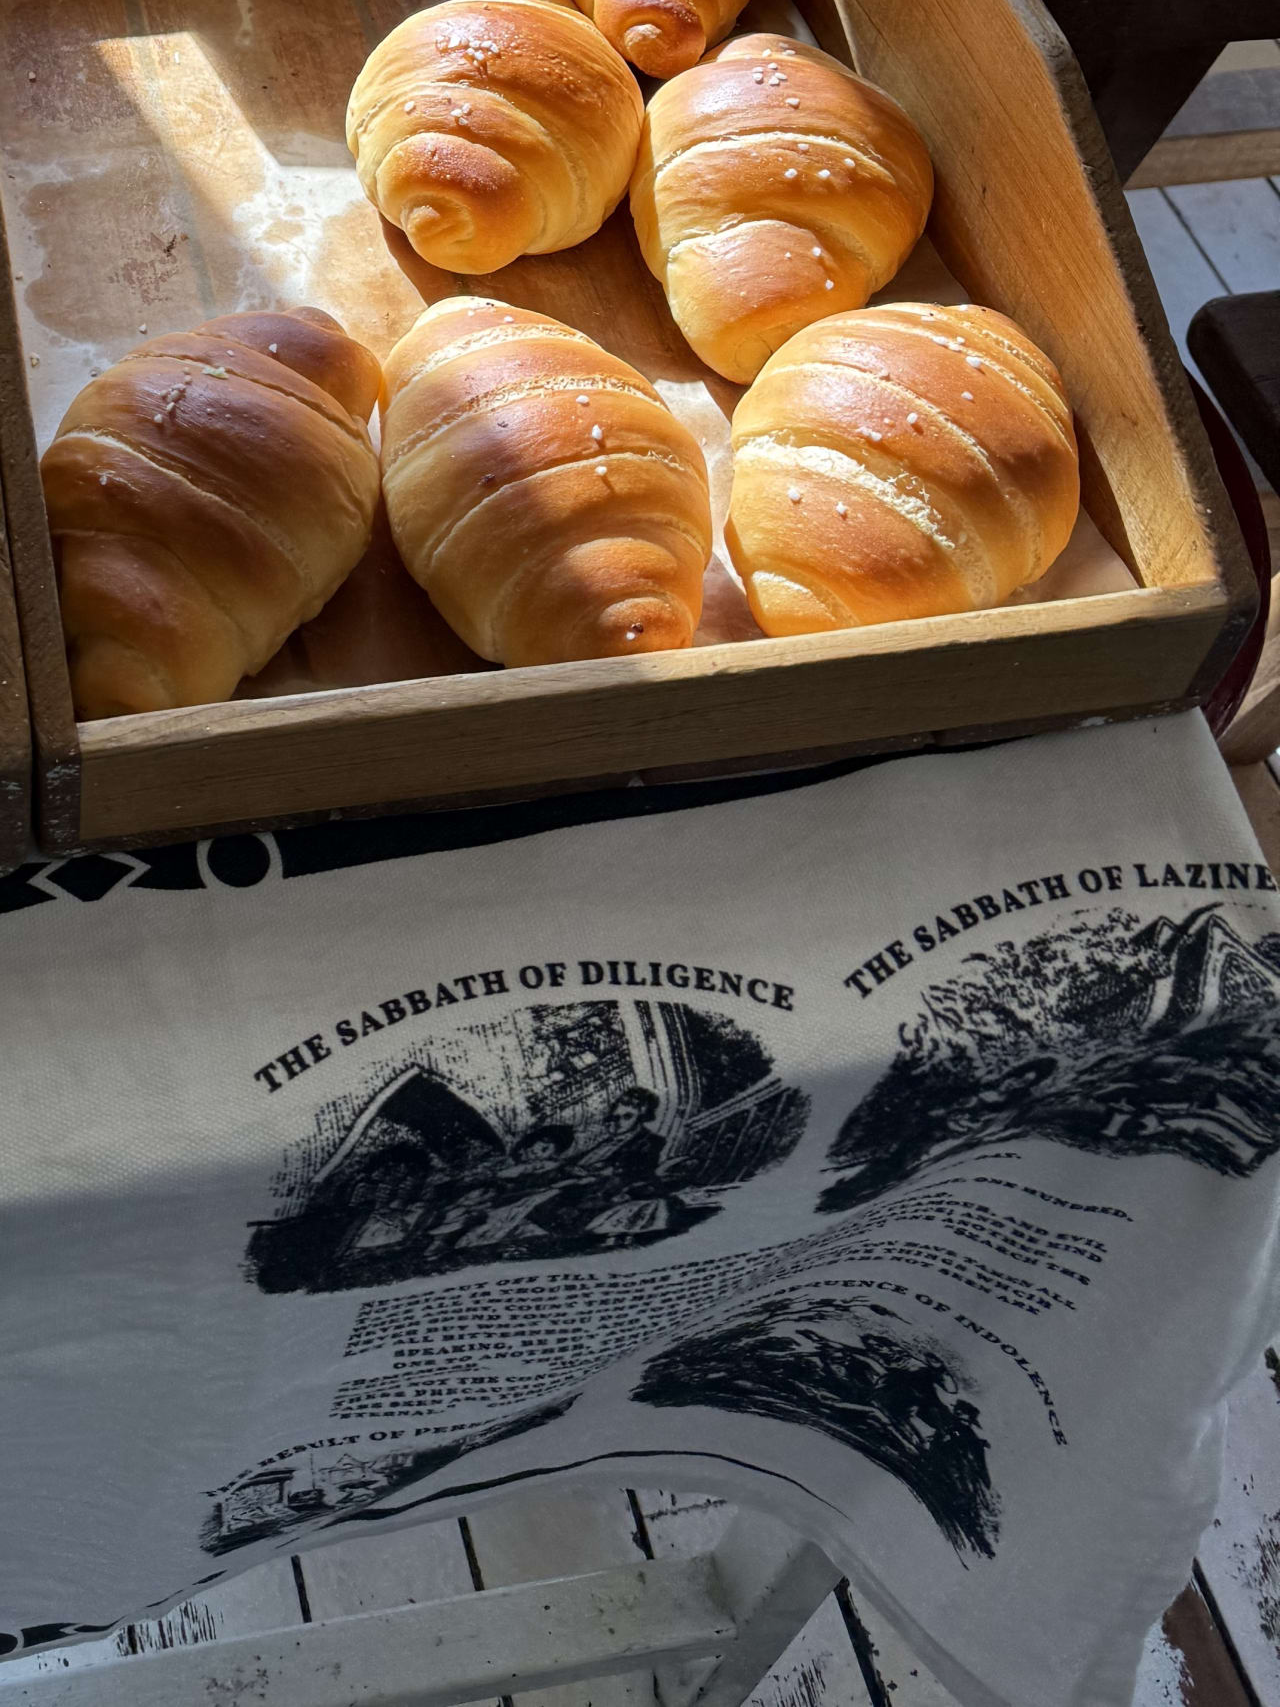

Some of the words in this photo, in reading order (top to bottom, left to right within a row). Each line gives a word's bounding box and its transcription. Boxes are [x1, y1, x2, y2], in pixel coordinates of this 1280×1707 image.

[842, 940, 915, 999] THE
[913, 874, 1073, 953] SABBATH
[1078, 865, 1124, 893] OF
[254, 1034, 334, 1093] THE
[334, 969, 511, 1048] SABBATH
[519, 963, 569, 989] OF
[578, 961, 796, 1012] DILIGENCE
[368, 1429, 406, 1442] OF
[915, 1293, 951, 1313] OF
[954, 1312, 1070, 1446] INDOLENCE
